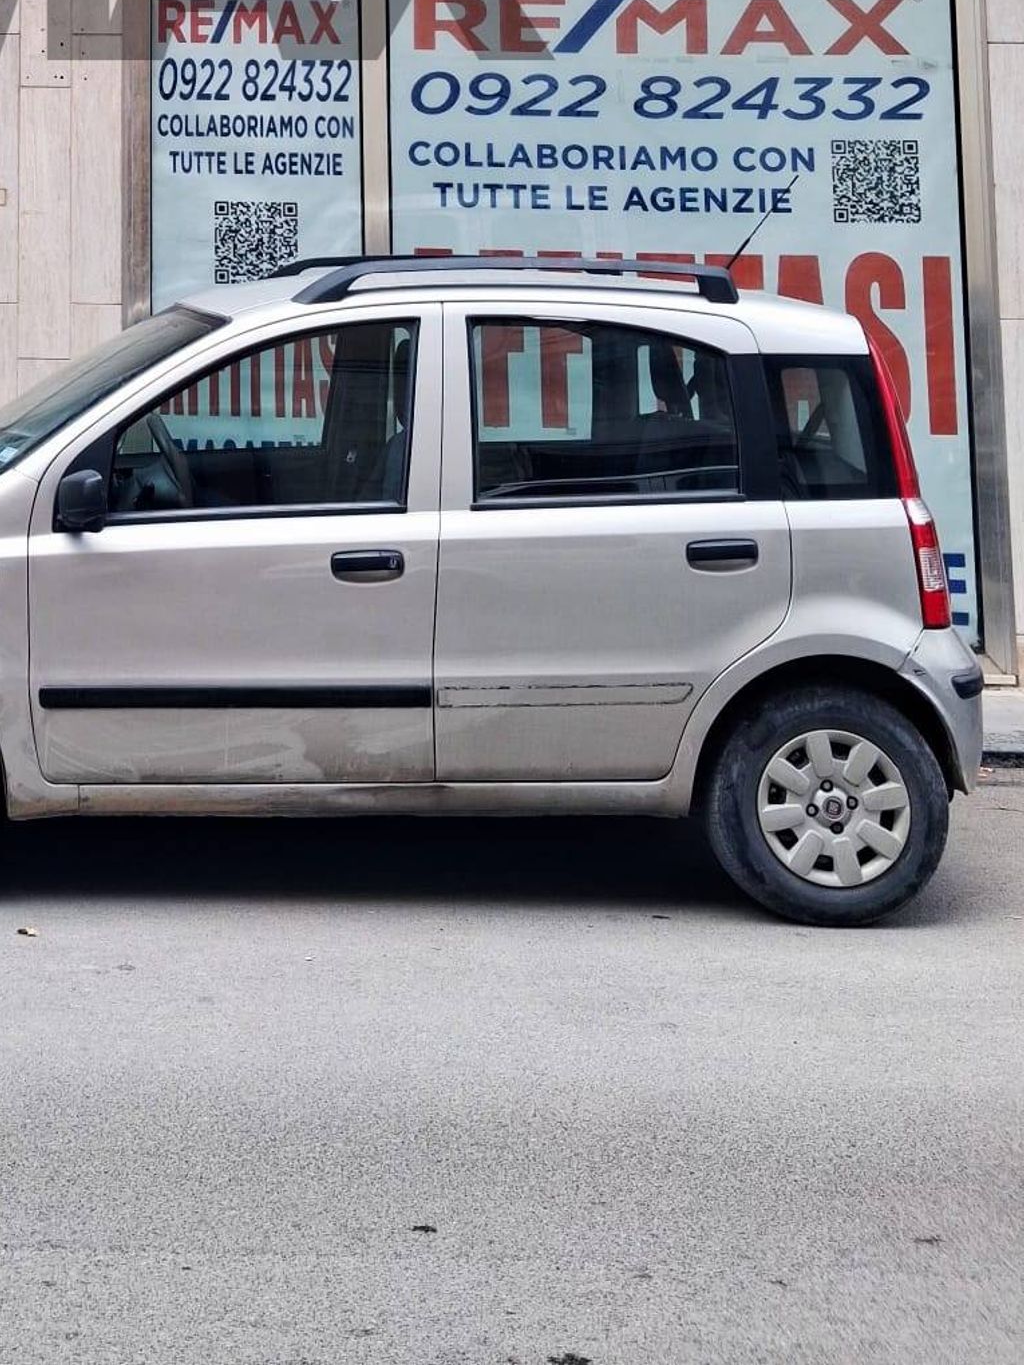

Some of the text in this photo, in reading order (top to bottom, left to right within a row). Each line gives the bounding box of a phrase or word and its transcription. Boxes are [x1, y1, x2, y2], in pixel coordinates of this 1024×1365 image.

[158, 57, 352, 102] 0922 824332
[410, 71, 931, 121] 0922 824332
[157, 114, 355, 139] COLLABORIAMO CON
[169, 151, 343, 176] TUTTE LE AGENZIE
[408, 140, 816, 173] COLLABORIAMO CON
[432, 181, 793, 214] TUTTE LE AGENZIE
